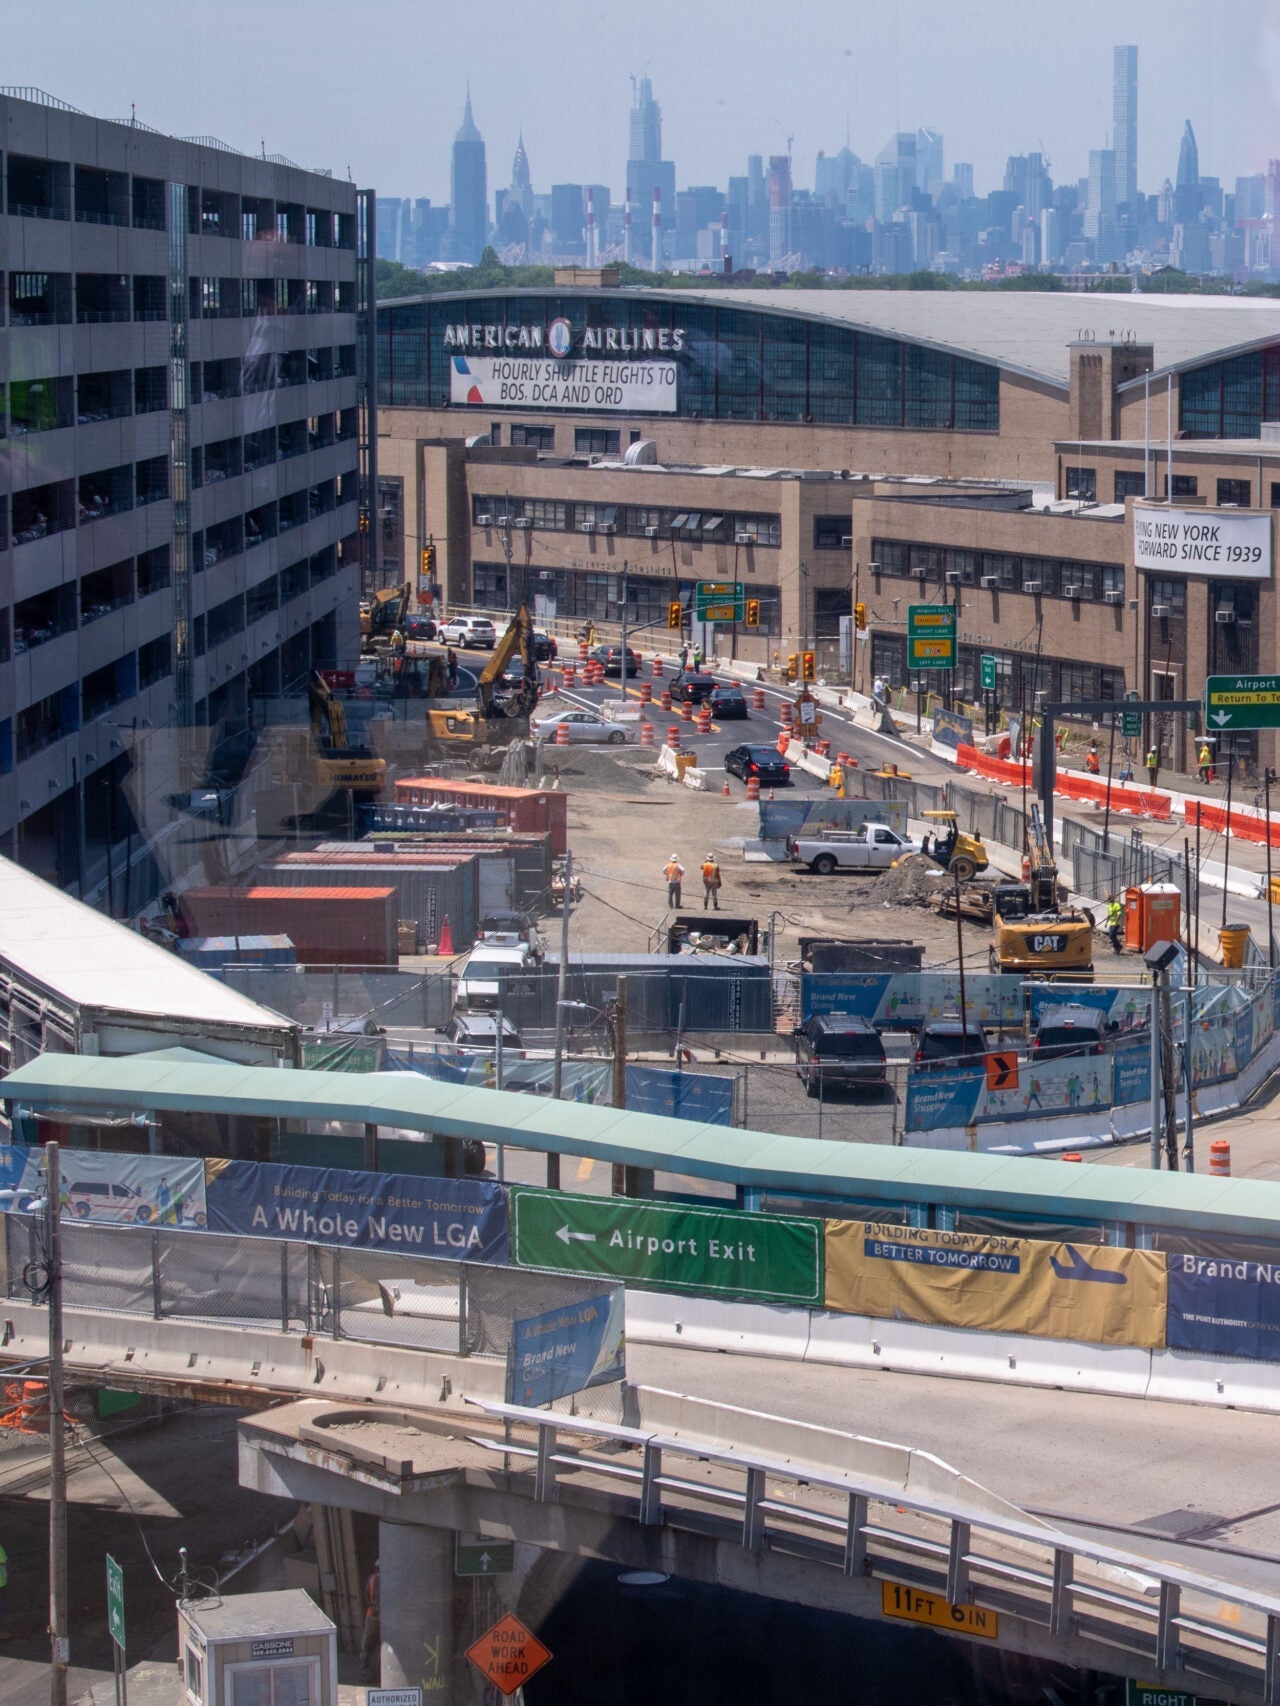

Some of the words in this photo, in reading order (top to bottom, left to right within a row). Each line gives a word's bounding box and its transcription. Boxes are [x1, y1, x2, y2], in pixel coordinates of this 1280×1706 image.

[443, 324, 542, 348] AMERICAN
[583, 327, 686, 351] AIRLINES
[493, 362, 542, 382] HOURLY
[544, 363, 598, 383] SHUTTLE
[602, 365, 654, 385] FLIGHTS
[659, 366, 676, 386] TO
[532, 384, 558, 402] DCA
[558, 385, 594, 404] AND
[595, 386, 623, 405] ORD
[1155, 523, 1179, 540] NEW
[1183, 525, 1220, 542] YORK
[1138, 540, 1178, 559] FORWARD
[1181, 543, 1222, 561] SINCE
[1226, 545, 1262, 563] 1939
[1236, 680, 1276, 690] Airport
[1217, 694, 1251, 703] Return
[1255, 694, 1267, 703] To
[330, 773, 377, 781] KOMATSU
[1034, 935, 1060, 952] CAT
[811, 992, 836, 1001] Brand
[838, 993, 856, 1001] New
[810, 1001, 835, 1011] Dining
[914, 1094, 937, 1103] Brand
[938, 1092, 955, 1100] New
[913, 1102, 946, 1114] Shopping
[273, 1184, 319, 1202] Building
[322, 1190, 354, 1205] Today
[357, 1194, 374, 1206] for
[377, 1198, 384, 1206] a
[388, 1196, 422, 1209] Better
[426, 1199, 485, 1215] Tomorrow
[252, 1205, 269, 1228] A
[276, 1207, 359, 1238] Whole
[368, 1215, 424, 1242] New
[433, 1221, 484, 1249] LGA
[610, 1228, 698, 1256] Airport
[708, 1239, 756, 1262] Exit
[864, 1223, 929, 1242] BUILDING
[933, 1231, 978, 1247] TODAY
[982, 1236, 1009, 1250] FOR
[1011, 1239, 1020, 1251] A
[874, 1243, 923, 1261] BETTER
[927, 1249, 1012, 1270] TOMORROW
[1183, 1254, 1247, 1281] Brand
[577, 1305, 599, 1323] LGA
[1182, 1312, 1195, 1321] THE
[1195, 1314, 1211, 1323] PORT
[1211, 1317, 1247, 1328] AUTHORITY
[523, 1345, 554, 1368] Brand
[554, 1342, 577, 1358] New
[109, 1575, 122, 1603] Exit
[492, 1630, 526, 1644] ROAD
[491, 1646, 526, 1659] WORK
[487, 1662, 528, 1675] AHEAD
[422, 1677, 448, 1691] WALL
[371, 1694, 417, 1704] AUTHORIZED
[1142, 1692, 1188, 1706] RIGHT
